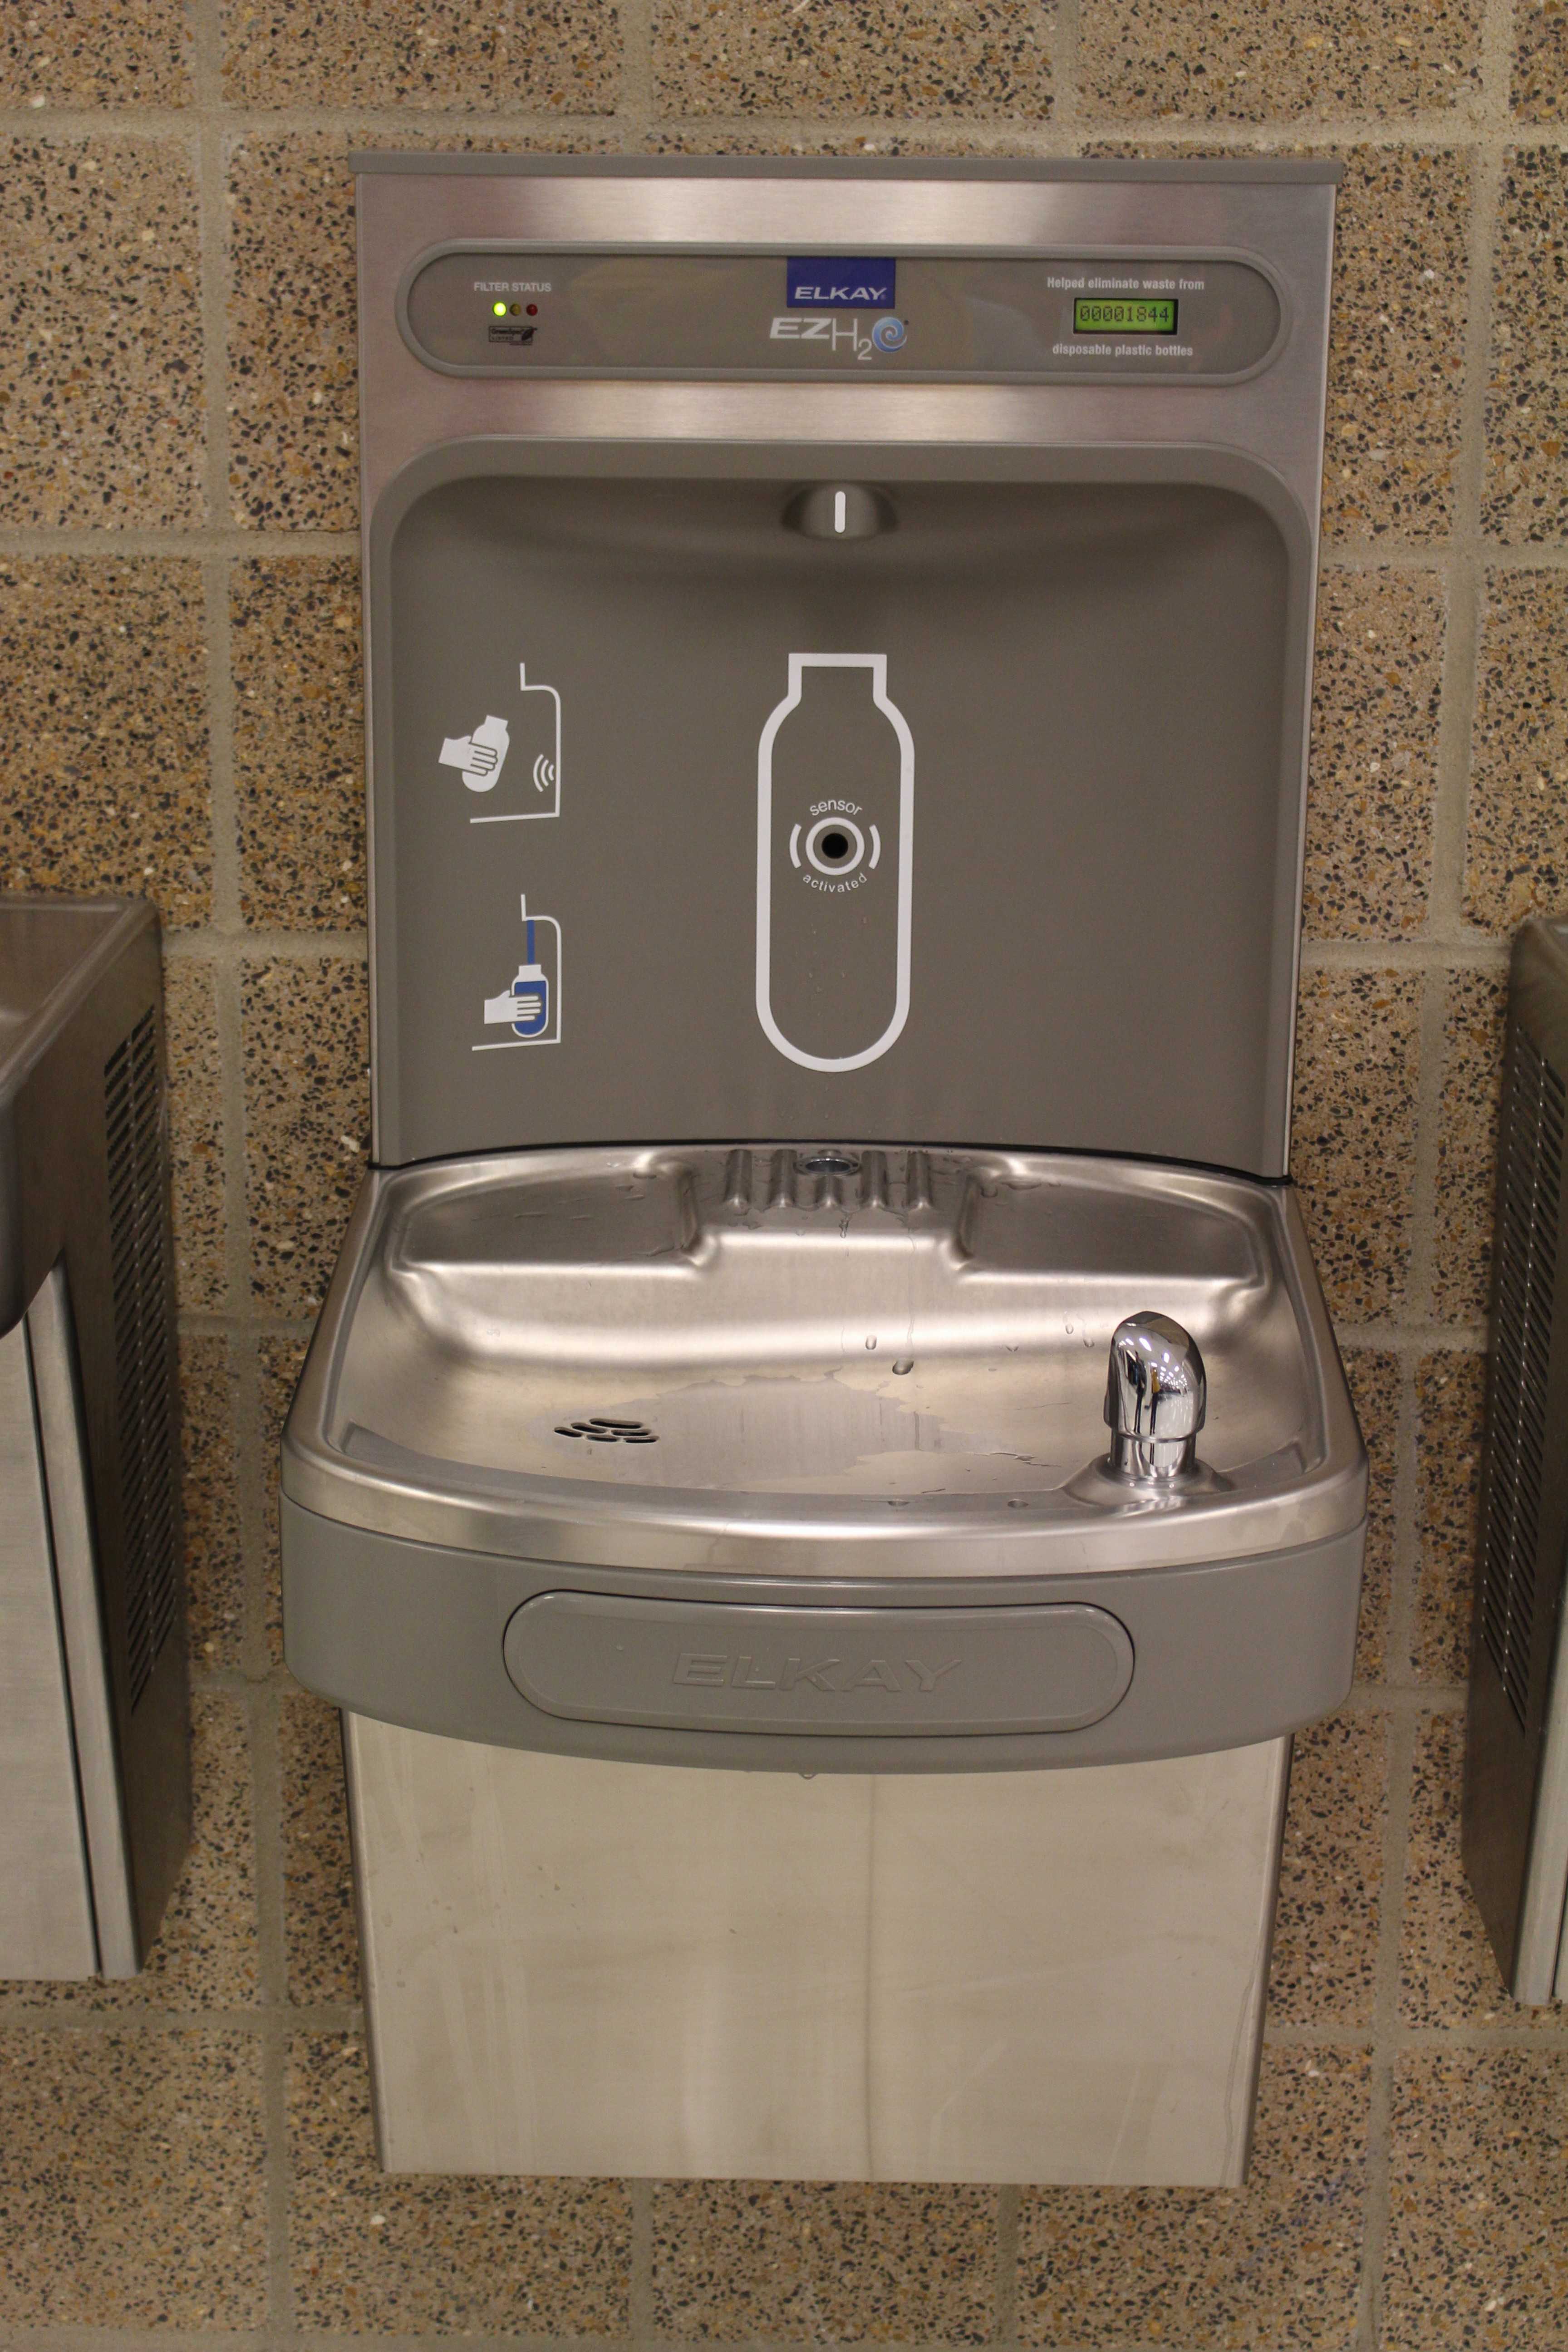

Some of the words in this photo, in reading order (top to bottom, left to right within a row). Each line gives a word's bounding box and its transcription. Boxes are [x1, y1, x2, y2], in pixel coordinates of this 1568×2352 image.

[474, 283, 509, 291] FILTER
[512, 283, 551, 292] STATUS
[1047, 277, 1085, 290] Helped
[1088, 278, 1139, 290] eliminate
[1143, 279, 1175, 290] waste
[1179, 279, 1204, 290] from
[795, 287, 887, 300] ELKAY
[1080, 305, 1169, 323] 00001844
[1052, 344, 1112, 357] disposable
[1115, 344, 1152, 357] plastic
[1155, 345, 1193, 356] bottles
[810, 799, 862, 816] sensor
[803, 873, 867, 893] activated
[673, 1653, 962, 1692] ELKAY
